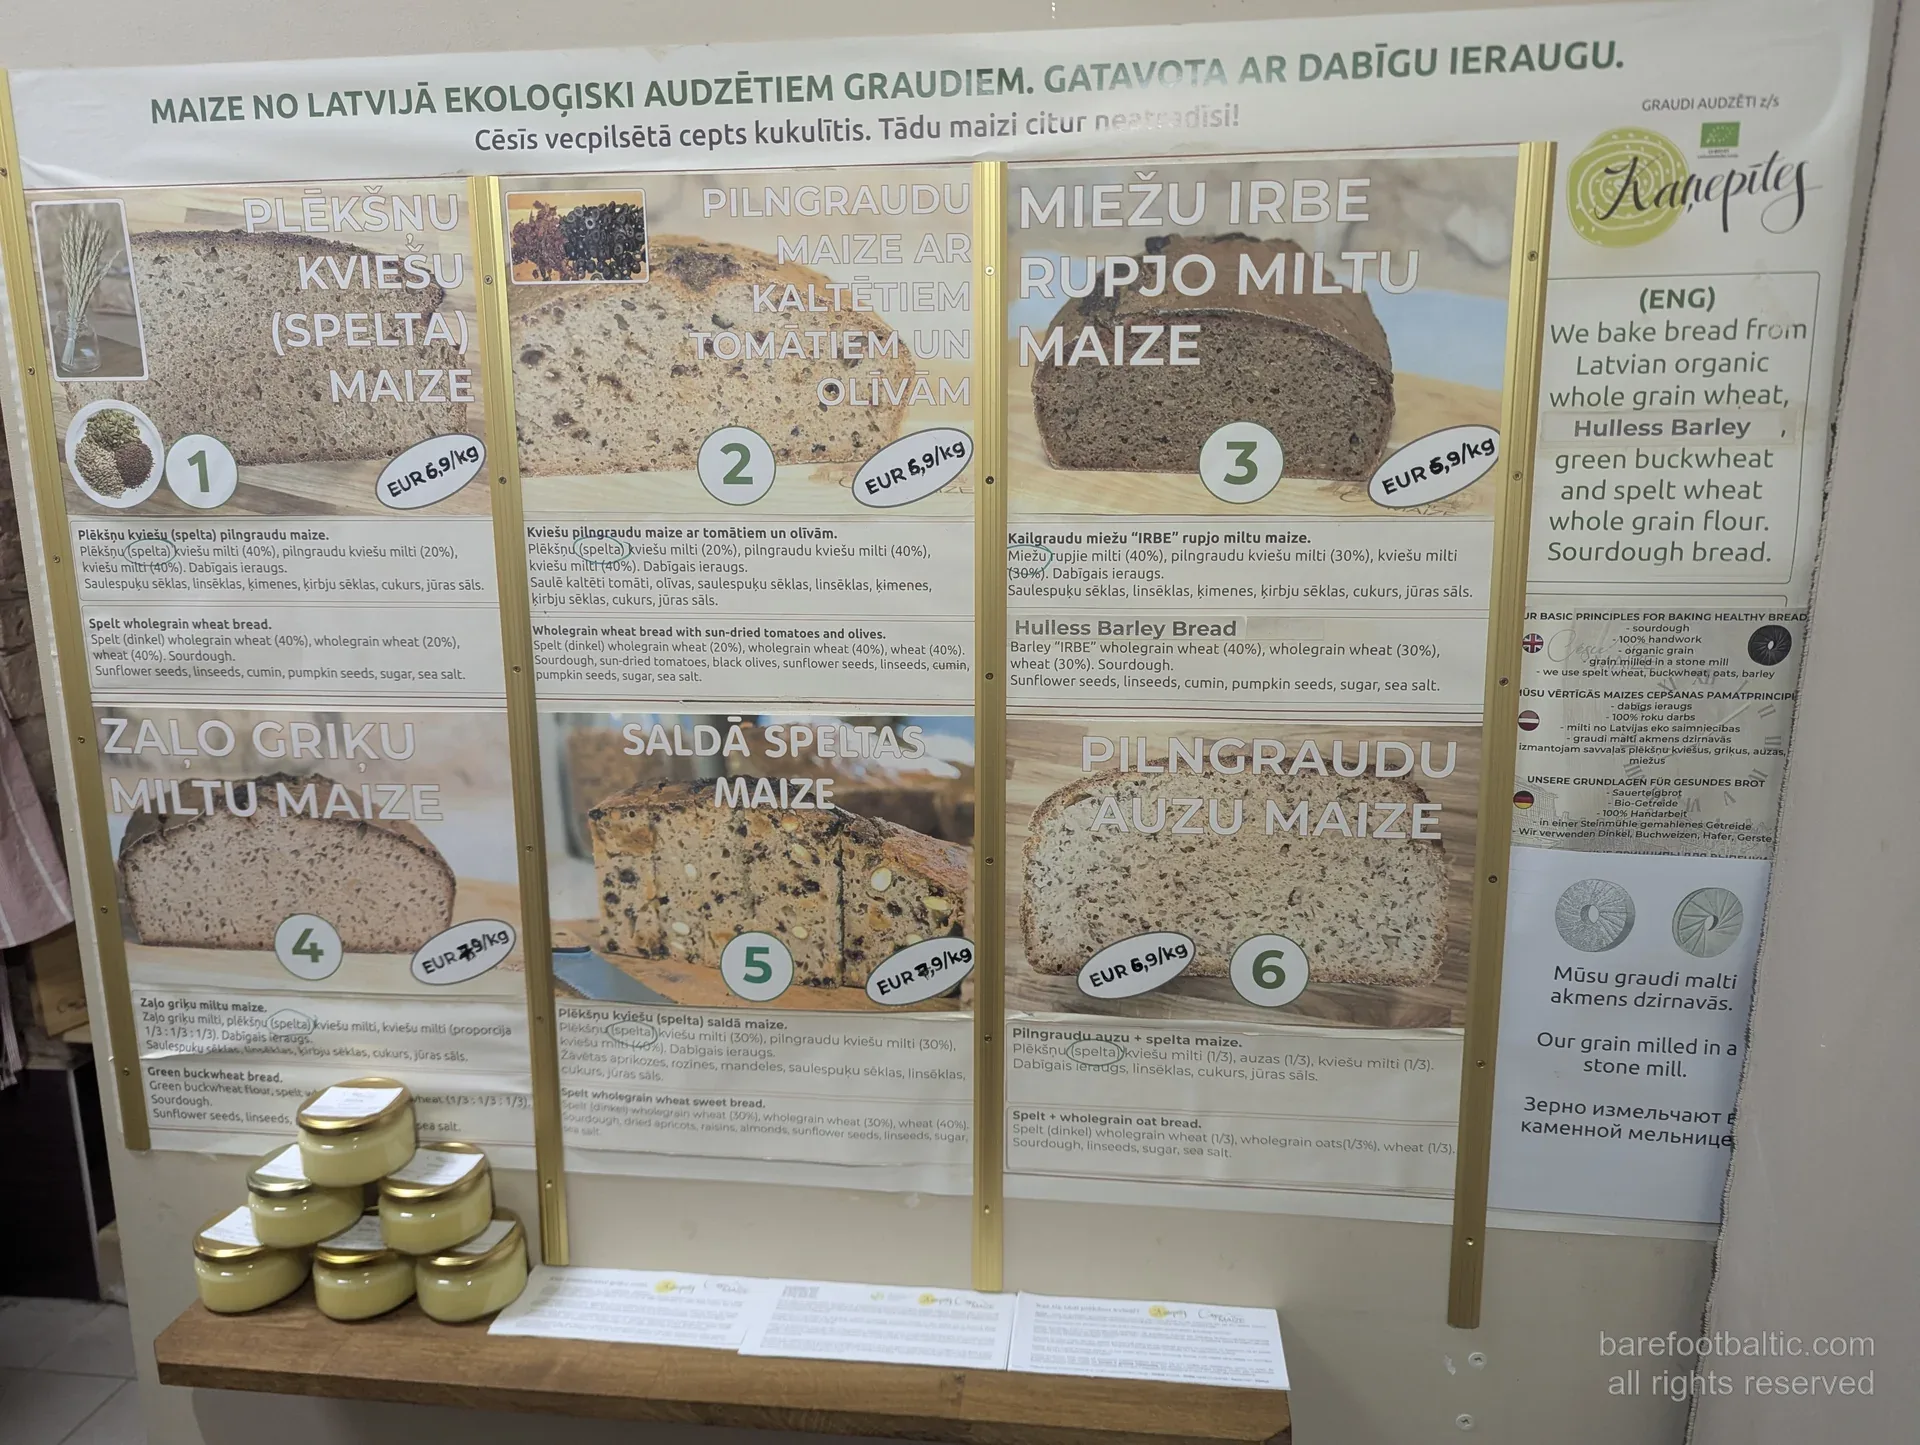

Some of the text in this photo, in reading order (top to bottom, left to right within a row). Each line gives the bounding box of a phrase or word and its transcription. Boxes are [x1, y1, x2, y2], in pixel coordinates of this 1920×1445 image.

[151, 41, 1624, 124] MAIZE NO LATVIJĀ EKOLOĢISKI AUDZĒTIEM GRAUDIEM. GATAVOTA AR DABĪGU IERAUGU.
[1642, 93, 1779, 112] GRAUDI AUDZĒTI z/s
[475, 129, 537, 151] Cēsīs
[545, 124, 671, 153] vecpilsētā
[679, 121, 747, 151] cepts
[754, 117, 871, 144] kukulītis.
[879, 115, 941, 141] Tādu
[949, 113, 1017, 138] maizi
[1026, 111, 1087, 136] citur
[243, 185, 459, 243] PLĒKŠŅU
[702, 183, 971, 218] PILNGRAUDU
[1019, 171, 1371, 229] MIEŽU IRBE
[776, 232, 972, 265] MAIZE AR
[298, 244, 464, 290] KVIEŠU
[1019, 250, 1419, 299] RUPJO MILTU
[752, 276, 971, 313] KALTĒTIEM
[1639, 287, 1715, 314] (ENG)
[272, 311, 469, 356] (SPELTA)
[689, 324, 971, 360] TOMĀTIEM UN
[1018, 324, 1200, 367] MAIZE
[1550, 318, 1807, 344] We bake bread from
[1576, 352, 1769, 378] Latvian organic
[329, 369, 475, 403] MAIZE
[817, 371, 971, 406] OLĪVĀM
[1549, 384, 1789, 411] whole grain wheat,
[1573, 418, 1751, 439] Hulless Barley
[187, 449, 210, 493] 1
[387, 446, 479, 497] EUR 6,9/kg
[719, 442, 753, 485] 2
[865, 441, 965, 495] EUR 6,9/kg
[1223, 441, 1259, 485] 3
[1382, 438, 1495, 495] EUR 6,9/kg
[1555, 446, 1774, 473] green buckwheat
[1560, 478, 1763, 504] and spelt wheat
[78, 529, 329, 544] Plēkšņu kviešu (spelta) pilngraudu maize.
[1548, 509, 1769, 536] whole grain flour.
[1548, 541, 1771, 566] Sourdough bread.
[89, 618, 272, 631] Spelt wholegrain wheat bread.
[532, 625, 886, 640] Wholegrain wheat bread with sun-dried tomatoes and olives.
[1015, 619, 1236, 640] Hulless Barley Bread
[1540, 612, 1573, 620] BASIC
[1576, 612, 1640, 621] PRINCIPLES
[1643, 612, 1665, 621] FOR
[1668, 612, 1711, 621] BAKING
[1715, 612, 1765, 621] HEALTHY
[1768, 613, 1807, 621] BREAD
[100, 717, 416, 773] ZAĻO GRIĶU
[622, 716, 926, 759] SALDĀ SPELTAS
[1081, 735, 1457, 779] PILNGRAUDU
[109, 777, 444, 821] MILTU MAIZE
[714, 777, 835, 810] MAIZE
[1091, 797, 1443, 840] AUZU MAIZE
[291, 928, 324, 963] 4
[422, 952, 457, 974] EUR
[743, 946, 773, 984] 5
[1089, 944, 1188, 987] EUR 6,9/kg
[1252, 950, 1287, 990] 6
[1554, 965, 1737, 989] Mūsu graudi malti
[877, 971, 915, 995] EUR
[1551, 988, 1733, 1011] akmens dzirnavās.
[558, 1008, 788, 1030] Plēkšņu kviešu (spelta) saldā maize.
[1012, 1027, 1092, 1044] Pilngraudu
[1095, 1032, 1130, 1043] auzu
[1146, 1034, 1190, 1048] spelta
[1195, 1036, 1243, 1048] maize.
[1537, 1032, 1737, 1056] Our grain milled in a
[148, 1066, 283, 1083] Green buckwheat bread.
[1583, 1059, 1687, 1078] stone mill.
[1012, 1110, 1045, 1122] Spelt
[1060, 1112, 1133, 1126] wholegrain
[1136, 1117, 1156, 1127] oat
[1161, 1117, 1201, 1129] bread.
[1524, 1097, 1586, 1116] Зерно
[1592, 1103, 1722, 1123] измельчают
[1521, 1120, 1622, 1139] каменной
